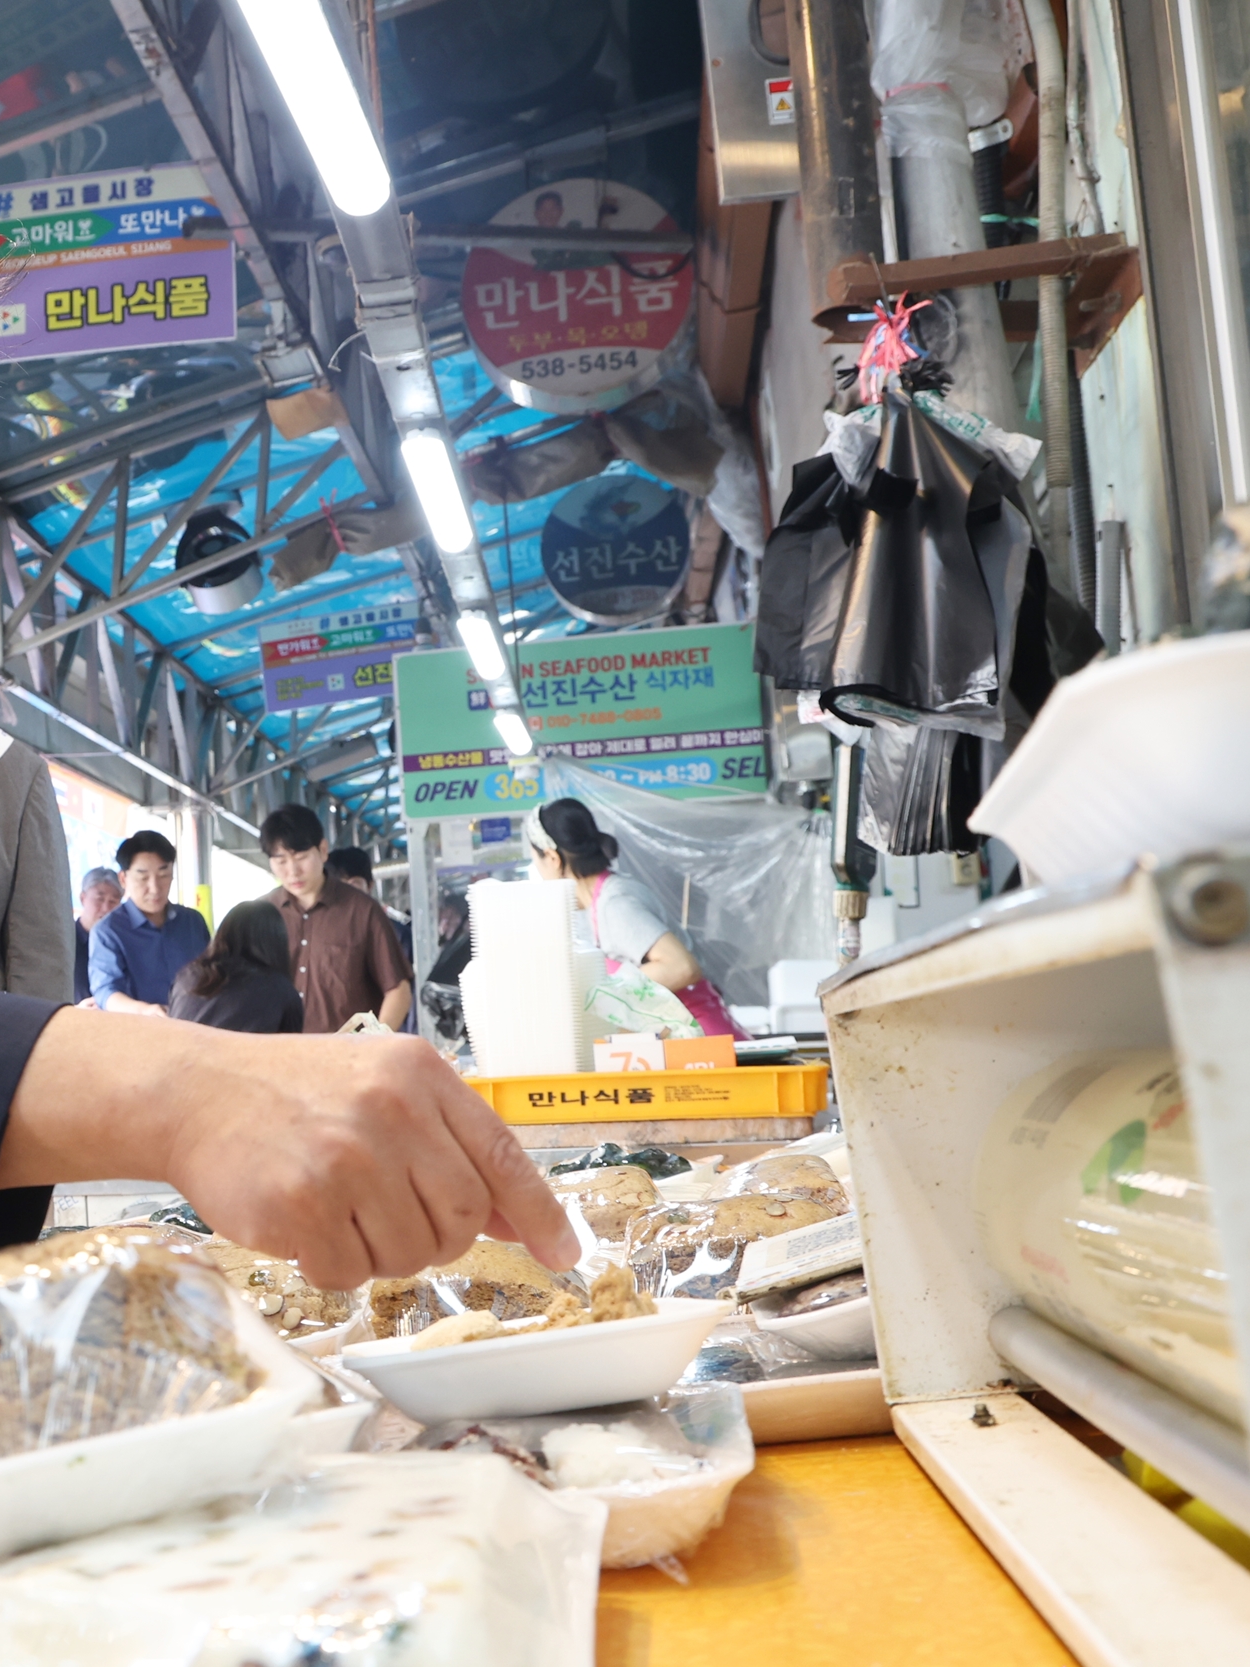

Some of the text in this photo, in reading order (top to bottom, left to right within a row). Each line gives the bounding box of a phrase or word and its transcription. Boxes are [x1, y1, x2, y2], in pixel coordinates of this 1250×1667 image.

[28, 177, 154, 211] 샘고을시장
[45, 274, 210, 332] 만나식품
[474, 259, 679, 331] 만나식품
[521, 349, 639, 380] 538-5454
[551, 535, 683, 583] 선진수산
[539, 655, 626, 678] SEAFOOD
[631, 647, 712, 669] MARKET
[522, 665, 715, 709] 선진수산 식자재
[414, 779, 479, 803] OPEN
[495, 773, 540, 799] 365
[665, 762, 712, 784] 8:30
[527, 1086, 656, 1108] 만나식품
